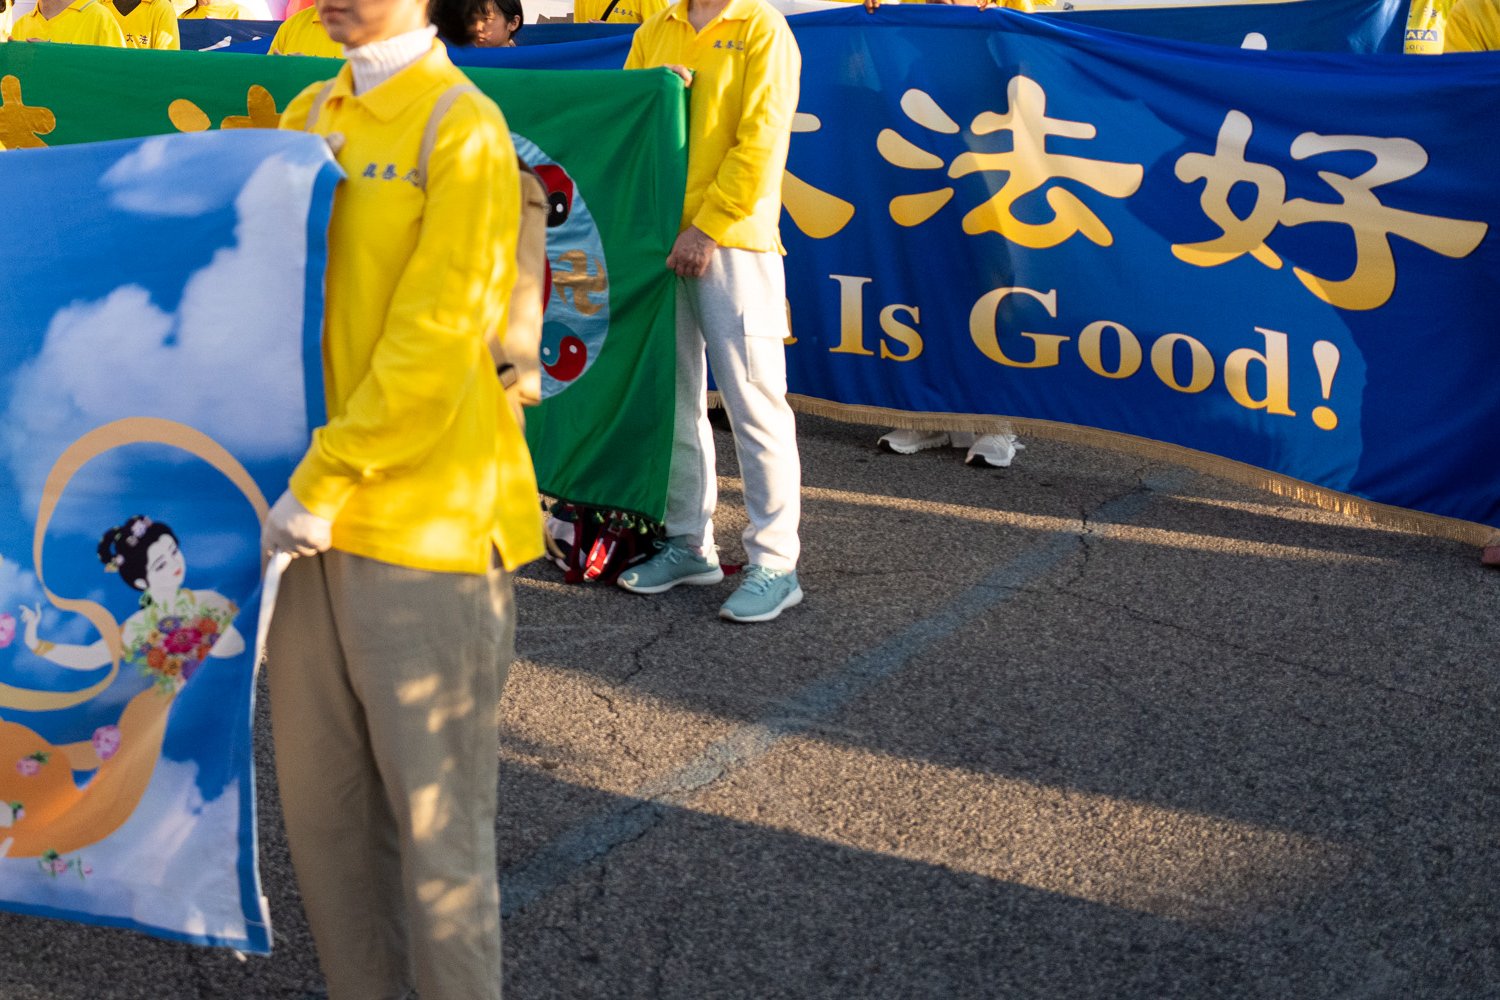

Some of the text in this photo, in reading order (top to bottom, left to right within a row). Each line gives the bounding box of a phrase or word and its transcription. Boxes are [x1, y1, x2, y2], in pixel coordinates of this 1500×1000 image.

[126, 33, 148, 45] 大法
[829, 274, 924, 363] Is
[969, 286, 1340, 432] Good!
